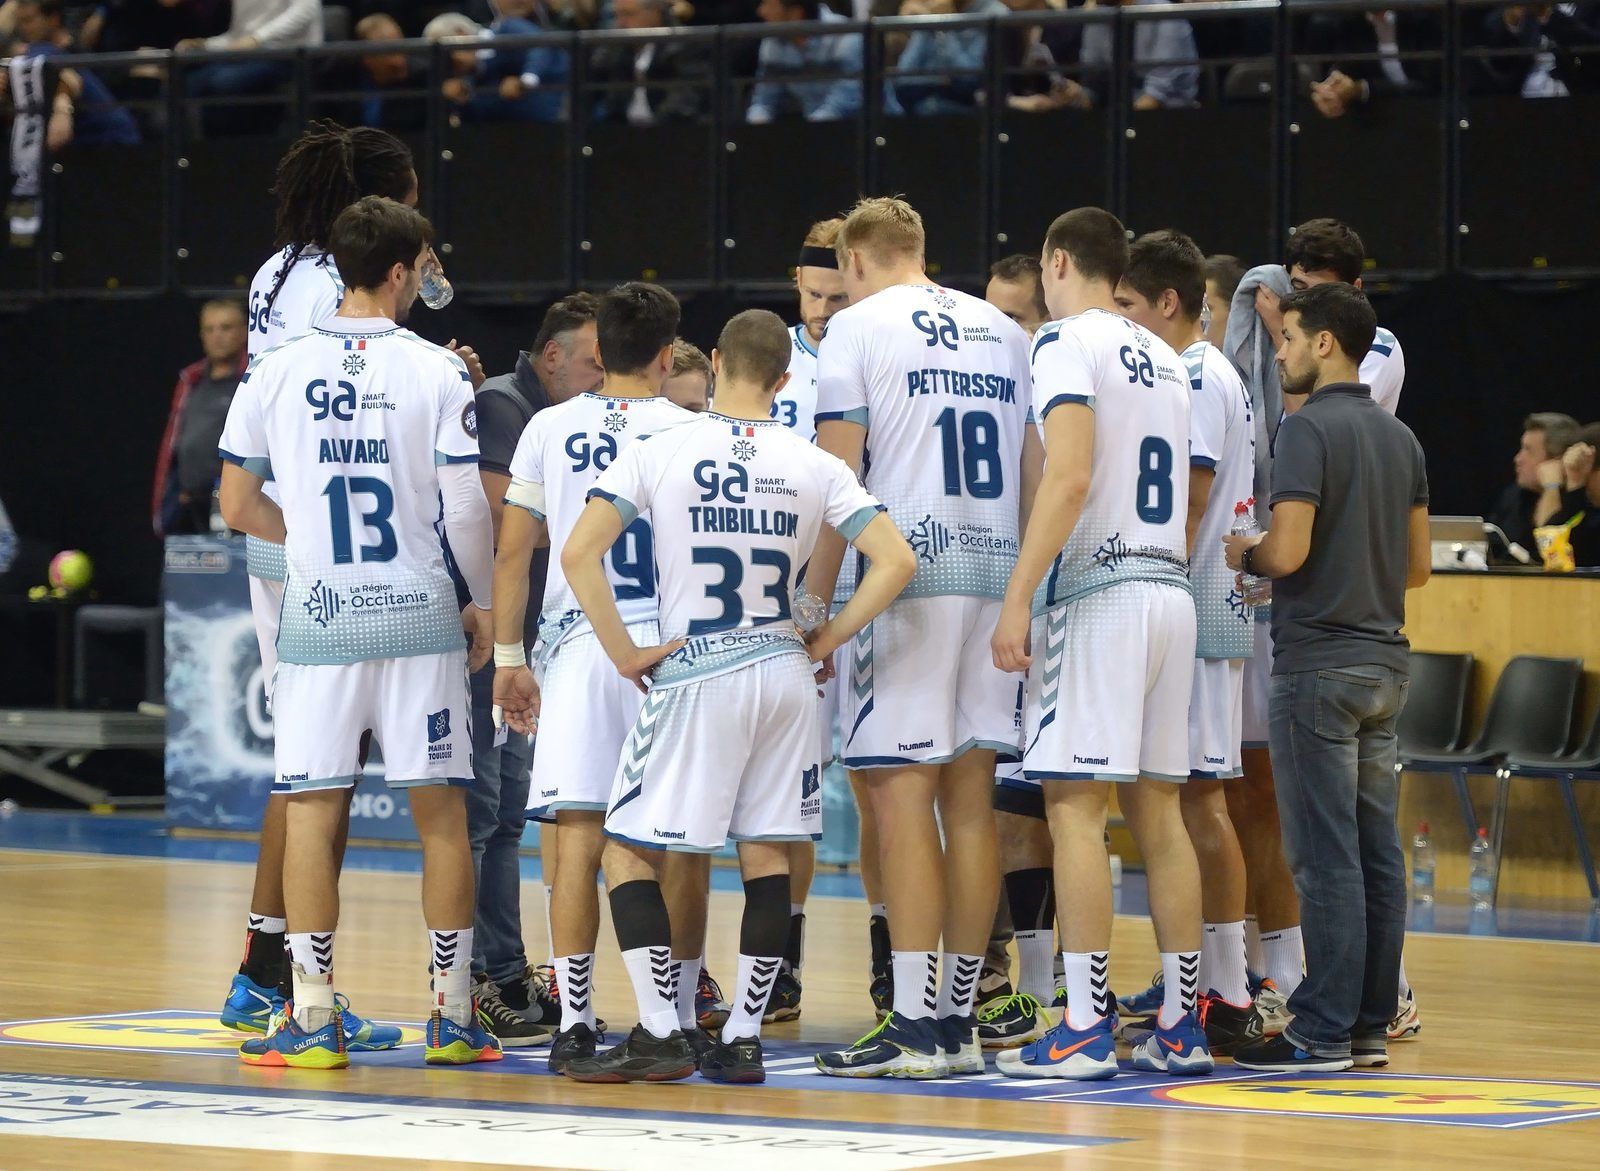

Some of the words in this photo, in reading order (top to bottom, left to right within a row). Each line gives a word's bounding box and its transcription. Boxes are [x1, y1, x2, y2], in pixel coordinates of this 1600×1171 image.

[912, 310, 959, 351] ga
[964, 334, 1002, 344] BUILDING
[1120, 346, 1154, 388] ga
[908, 368, 1016, 404] PETTERSSON
[306, 378, 356, 421] ga
[362, 393, 386, 401] SMART
[361, 402, 396, 410] BUILDING
[319, 438, 389, 464] ALVARO
[564, 432, 617, 472] ga
[932, 406, 1004, 499] 18
[694, 460, 748, 504] ga
[754, 478, 786, 486] SMART
[1136, 435, 1174, 525] 8
[754, 486, 798, 498] BUILDING
[320, 475, 398, 565] 13
[688, 506, 798, 539] TRIBILLON
[968, 524, 992, 534] Région
[1140, 544, 1148, 552] La
[1150, 545, 1172, 555] Région
[611, 517, 656, 600] 9
[350, 586, 360, 594] La
[362, 583, 393, 593] Région
[687, 546, 792, 636] 33
[352, 590, 428, 608] Occitanie
[428, 744, 446, 752] MAIRE
[898, 739, 934, 752] hummel
[428, 751, 452, 760] TOULOUSE
[1074, 754, 1109, 766] hummel
[1204, 756, 1224, 764] hummel
[282, 772, 308, 782] hummel
[541, 788, 558, 798] hummel
[654, 828, 686, 840] hummel
[294, 1033, 330, 1052] SALMING
